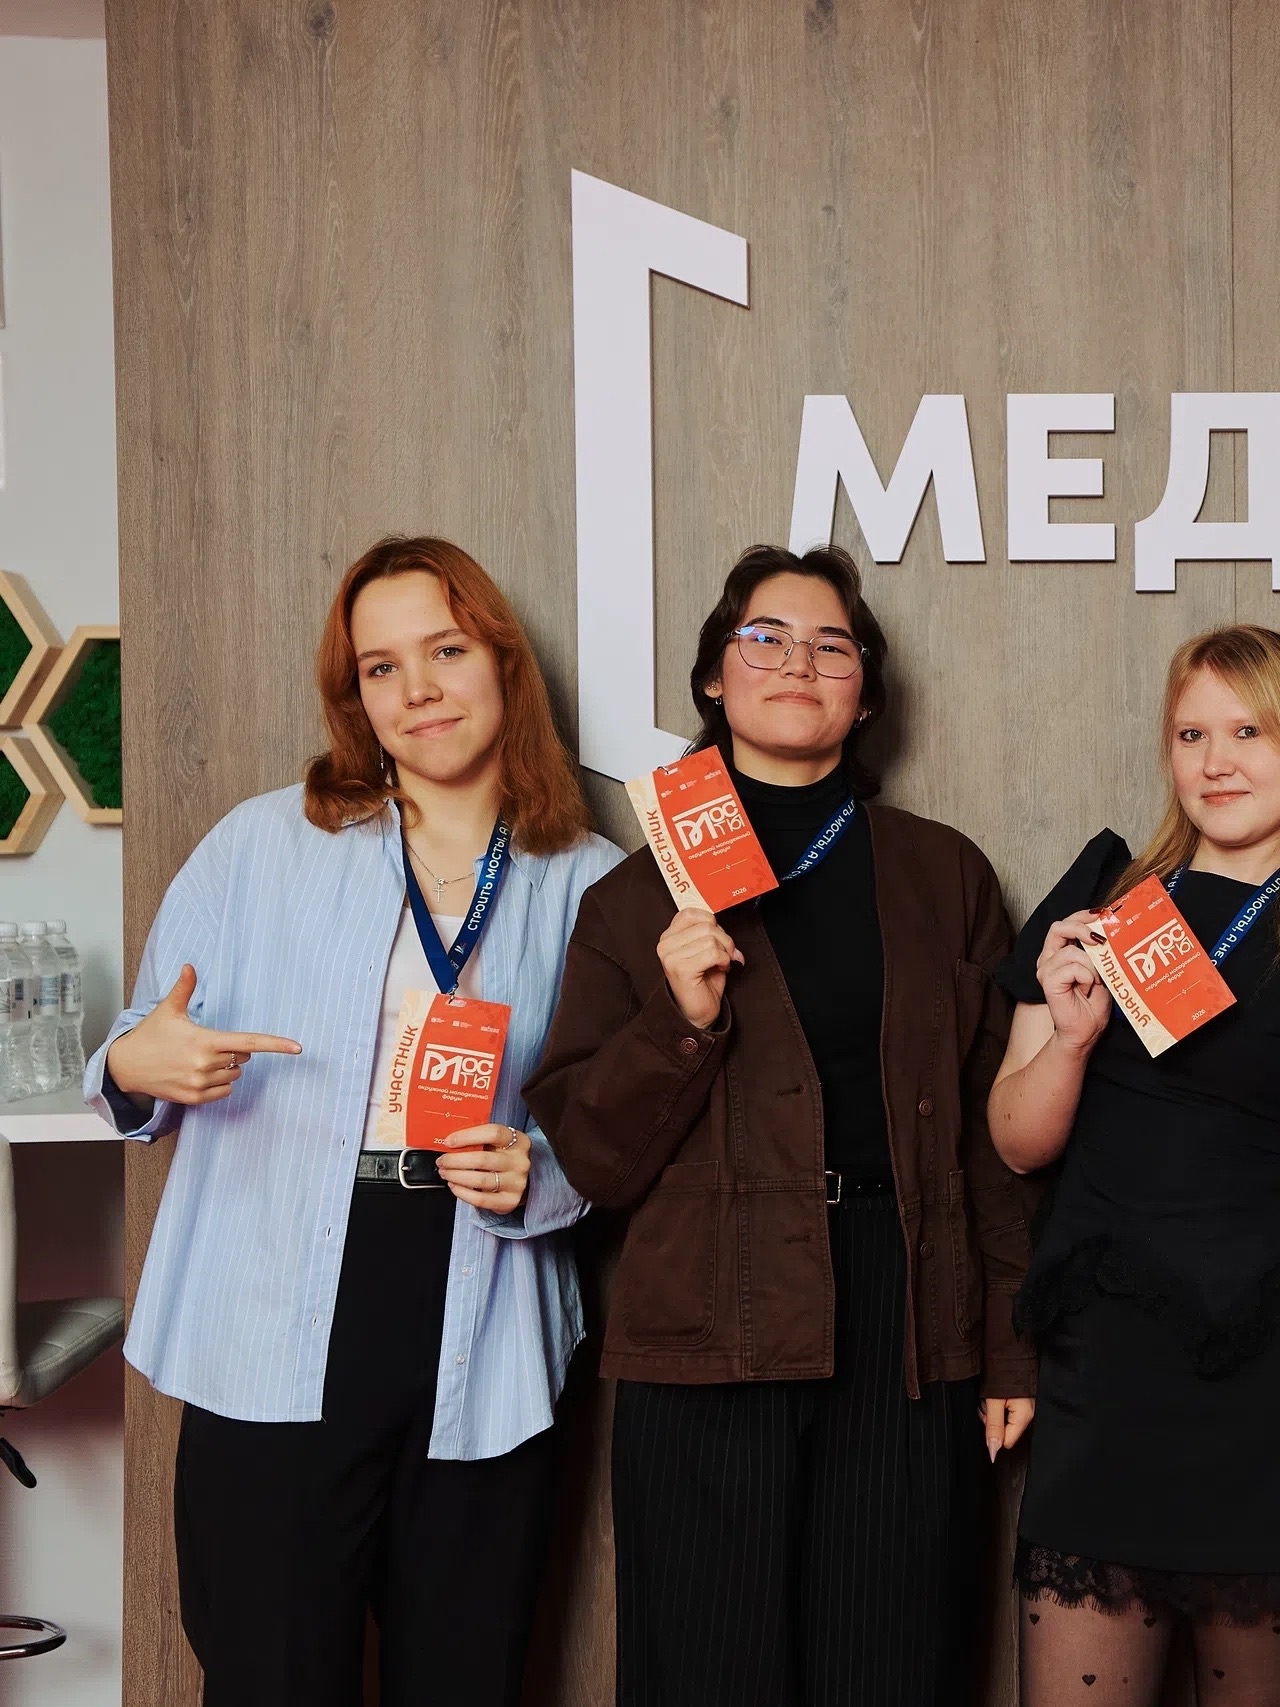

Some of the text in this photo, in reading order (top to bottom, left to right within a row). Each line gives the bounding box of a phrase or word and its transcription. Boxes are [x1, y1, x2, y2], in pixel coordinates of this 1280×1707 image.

[646, 809, 690, 893] УЧАСТНИК
[812, 815, 846, 850] МОСТЫ,
[807, 850, 819, 859] А
[468, 881, 493, 931] СТРОИТЬ
[485, 835, 507, 880] МОСТЫ,
[1231, 893, 1270, 932] МОСТЫ,
[1214, 942, 1231, 958] НЕ
[1226, 933, 1238, 943] А
[1099, 950, 1151, 1028] УЧАСТНИК
[389, 1024, 418, 1113] УЧАСТНИК
[433, 1137, 446, 1145] 202
